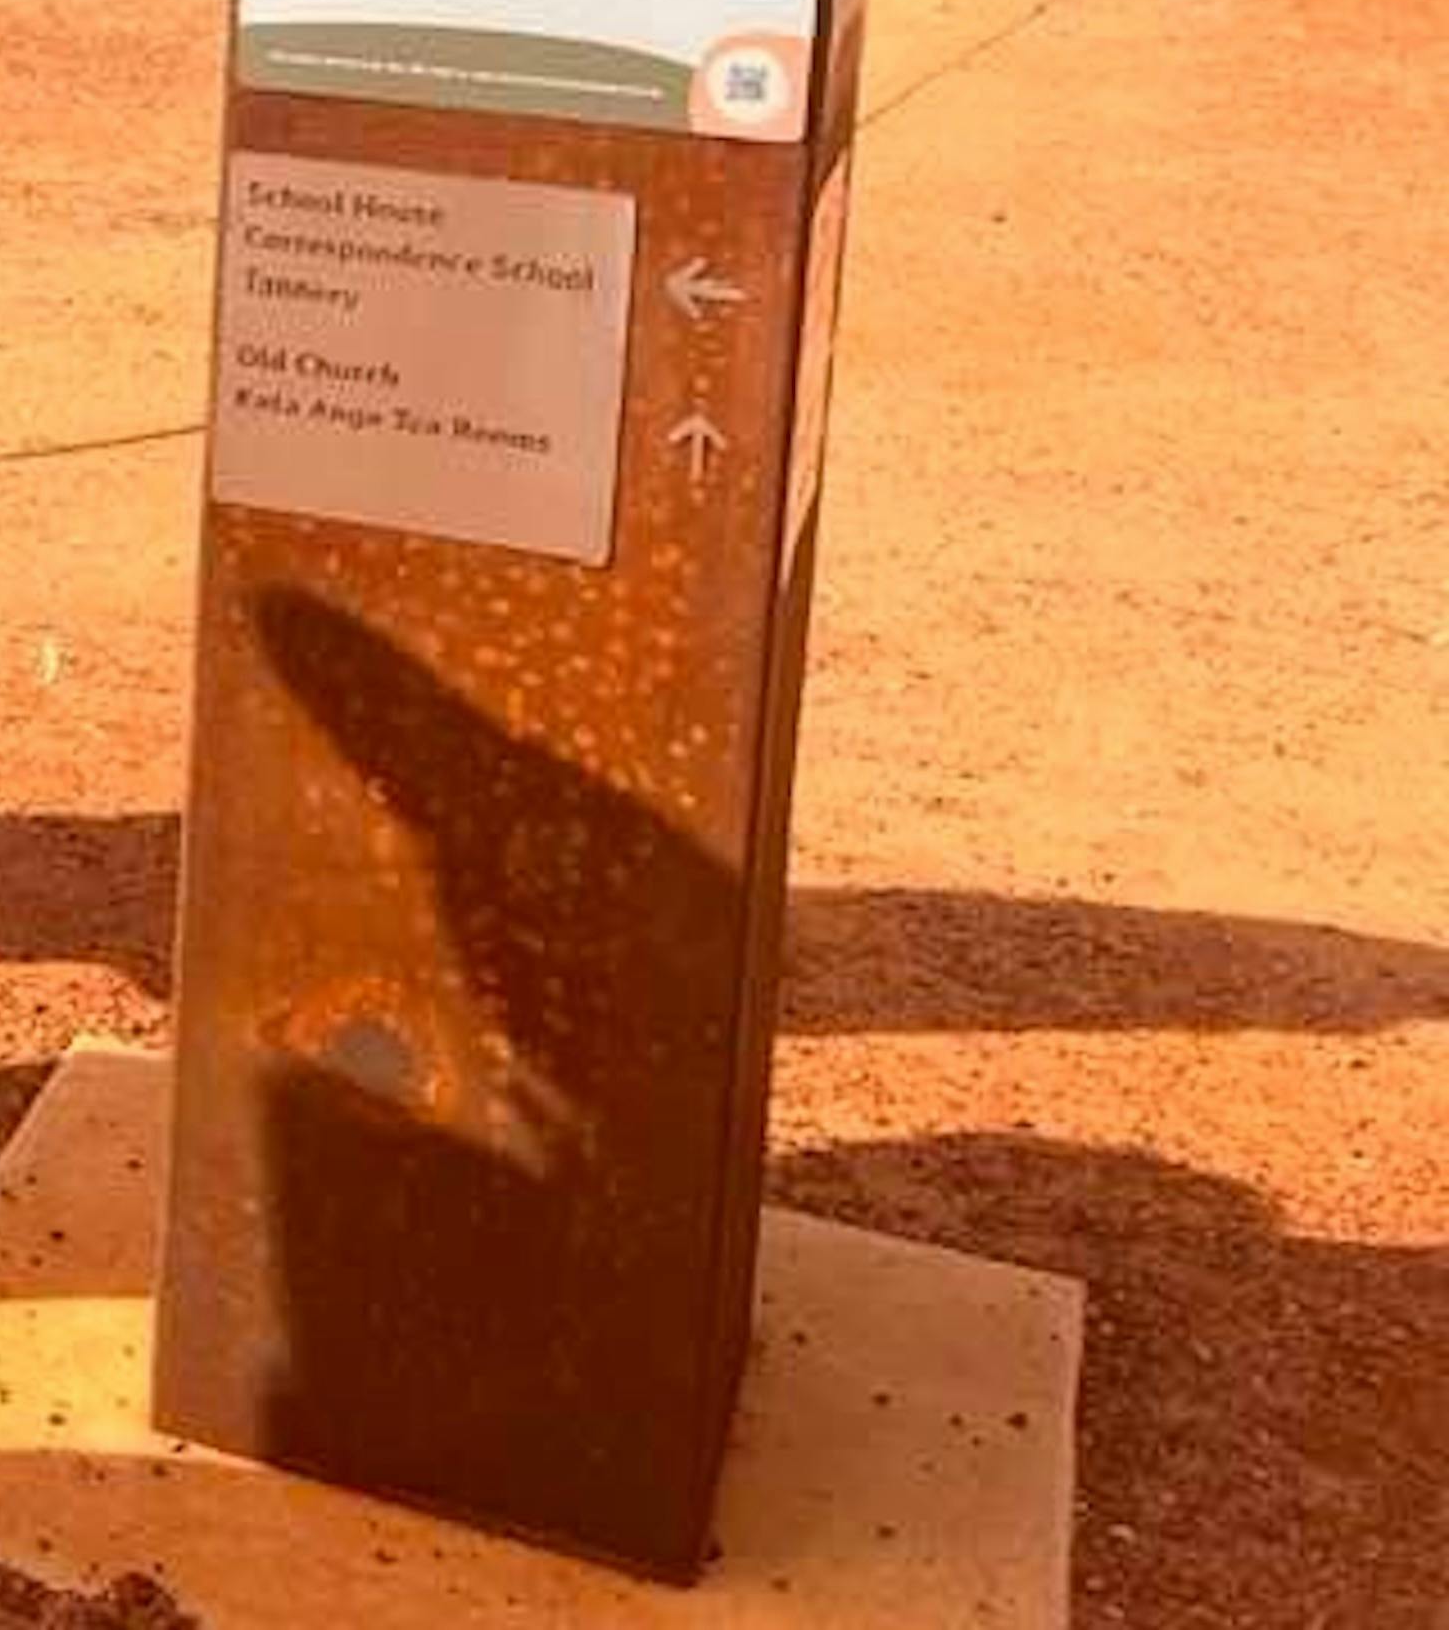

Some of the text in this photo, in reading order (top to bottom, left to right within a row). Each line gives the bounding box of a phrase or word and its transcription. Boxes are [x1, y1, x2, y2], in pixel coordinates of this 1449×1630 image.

[247, 181, 444, 227] School House
[244, 225, 595, 292] Correspondence School
[245, 267, 360, 311] Tannery
[236, 344, 400, 386] Old Church
[392, 407, 441, 436] Tea
[452, 416, 551, 453] Rooms
